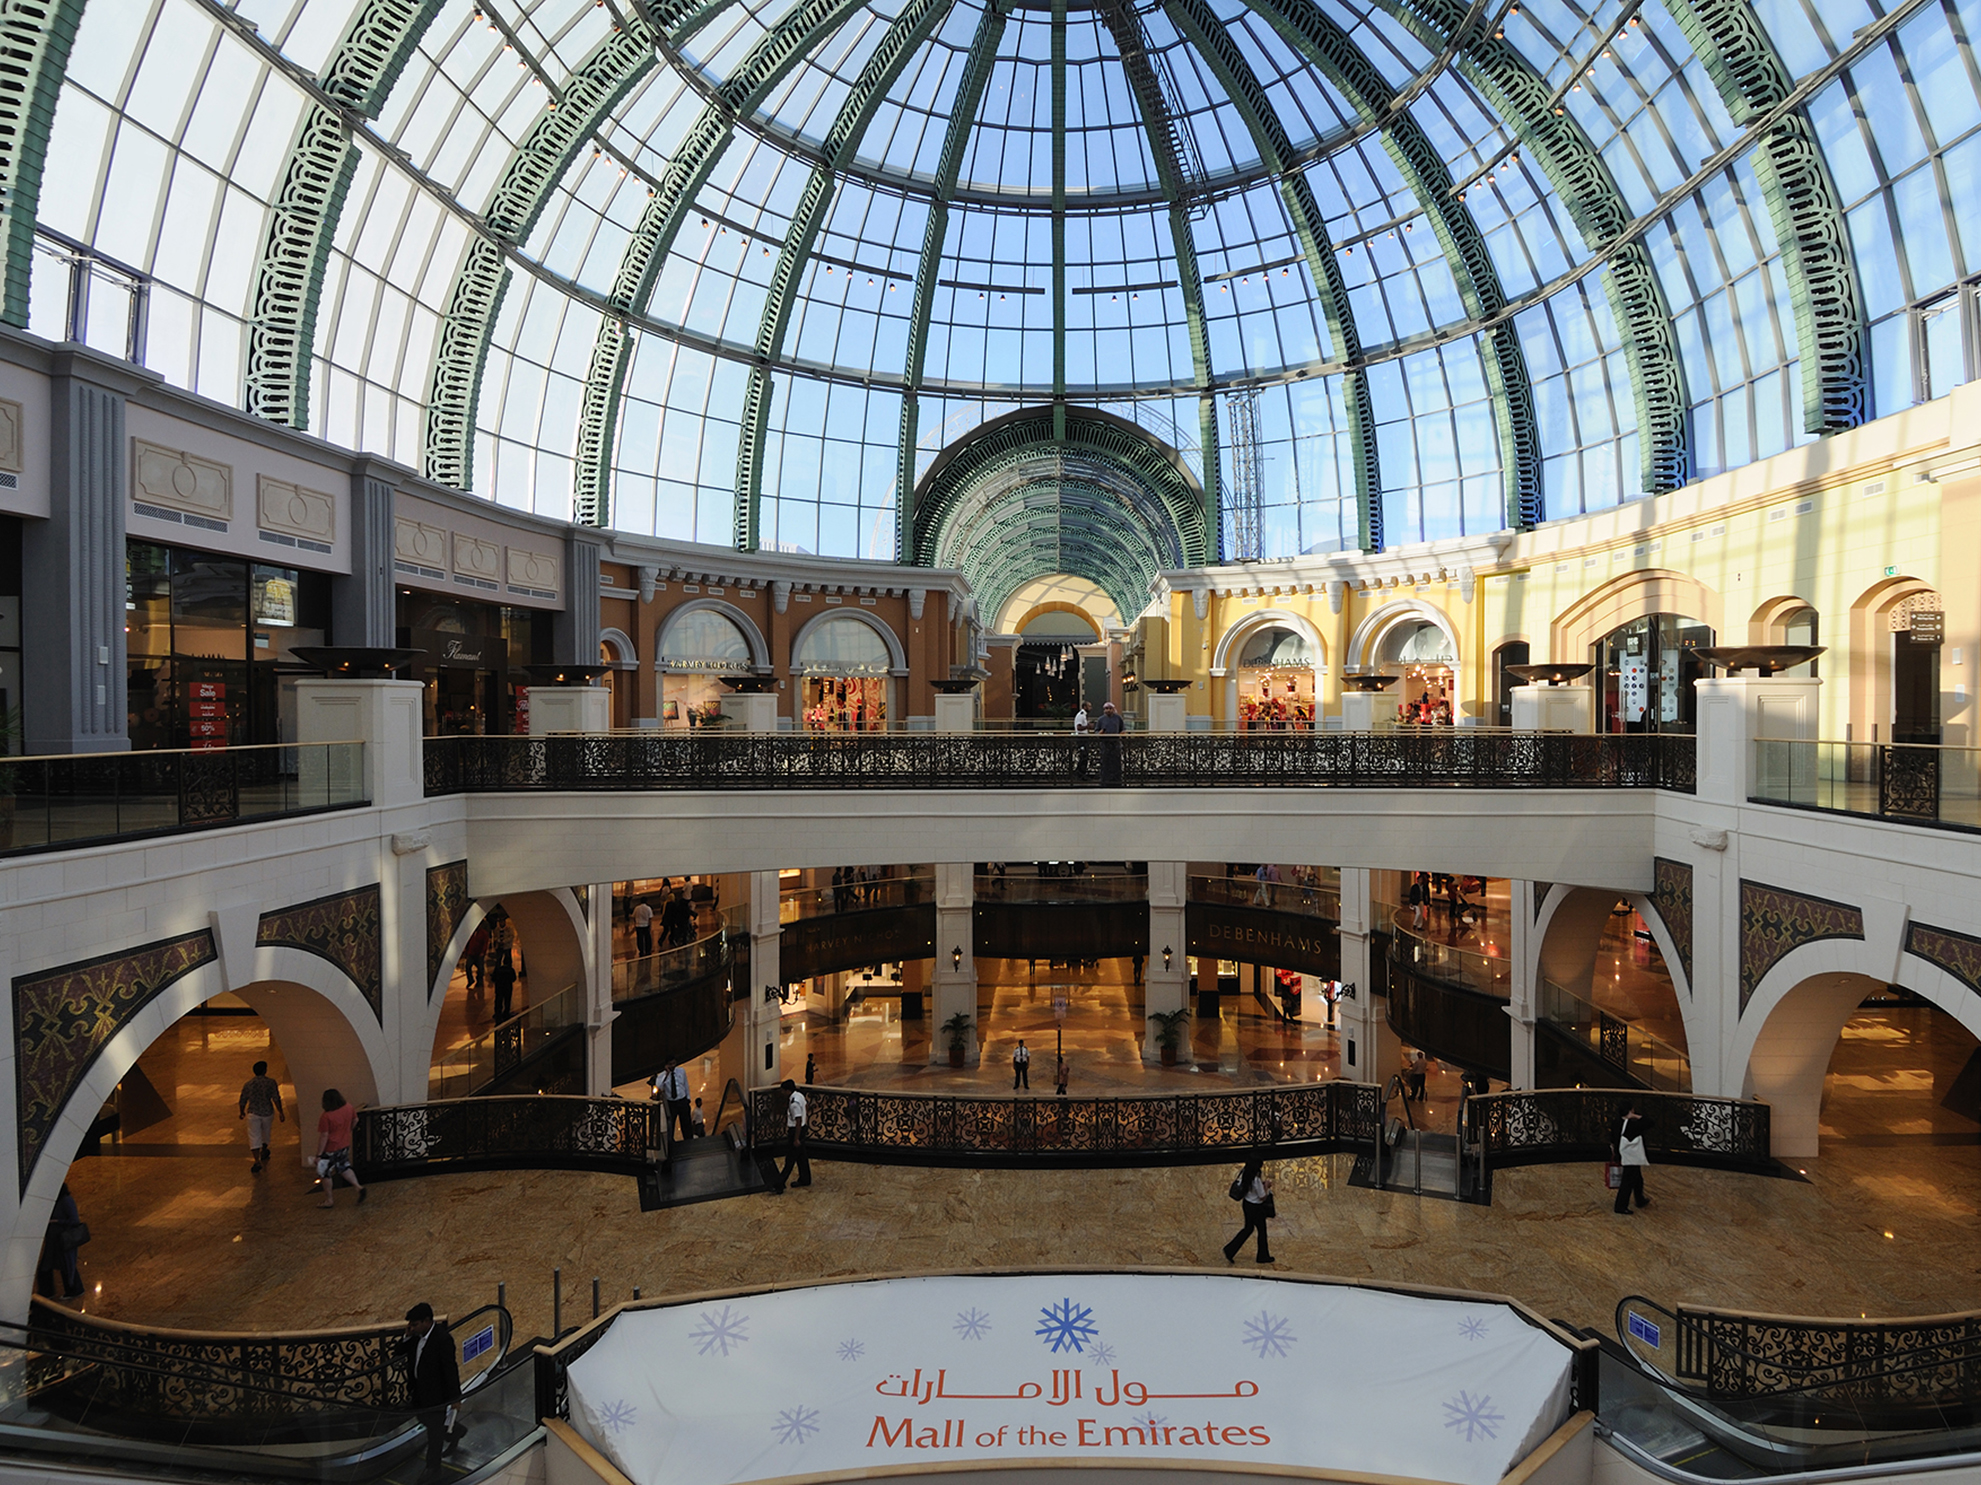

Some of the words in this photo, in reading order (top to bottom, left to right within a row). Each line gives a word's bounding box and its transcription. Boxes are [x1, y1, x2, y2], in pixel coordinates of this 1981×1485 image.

[443, 639, 482, 661] Flamant
[199, 688, 216, 697] Sale
[805, 936, 849, 953] HARVEY
[1209, 924, 1323, 955] DEBENHAMS
[1095, 1369, 1259, 1406] مول
[866, 1415, 964, 1448] Mall
[975, 1425, 1009, 1447] of
[1017, 1425, 1067, 1446] the
[1077, 1418, 1271, 1446] Emirates
